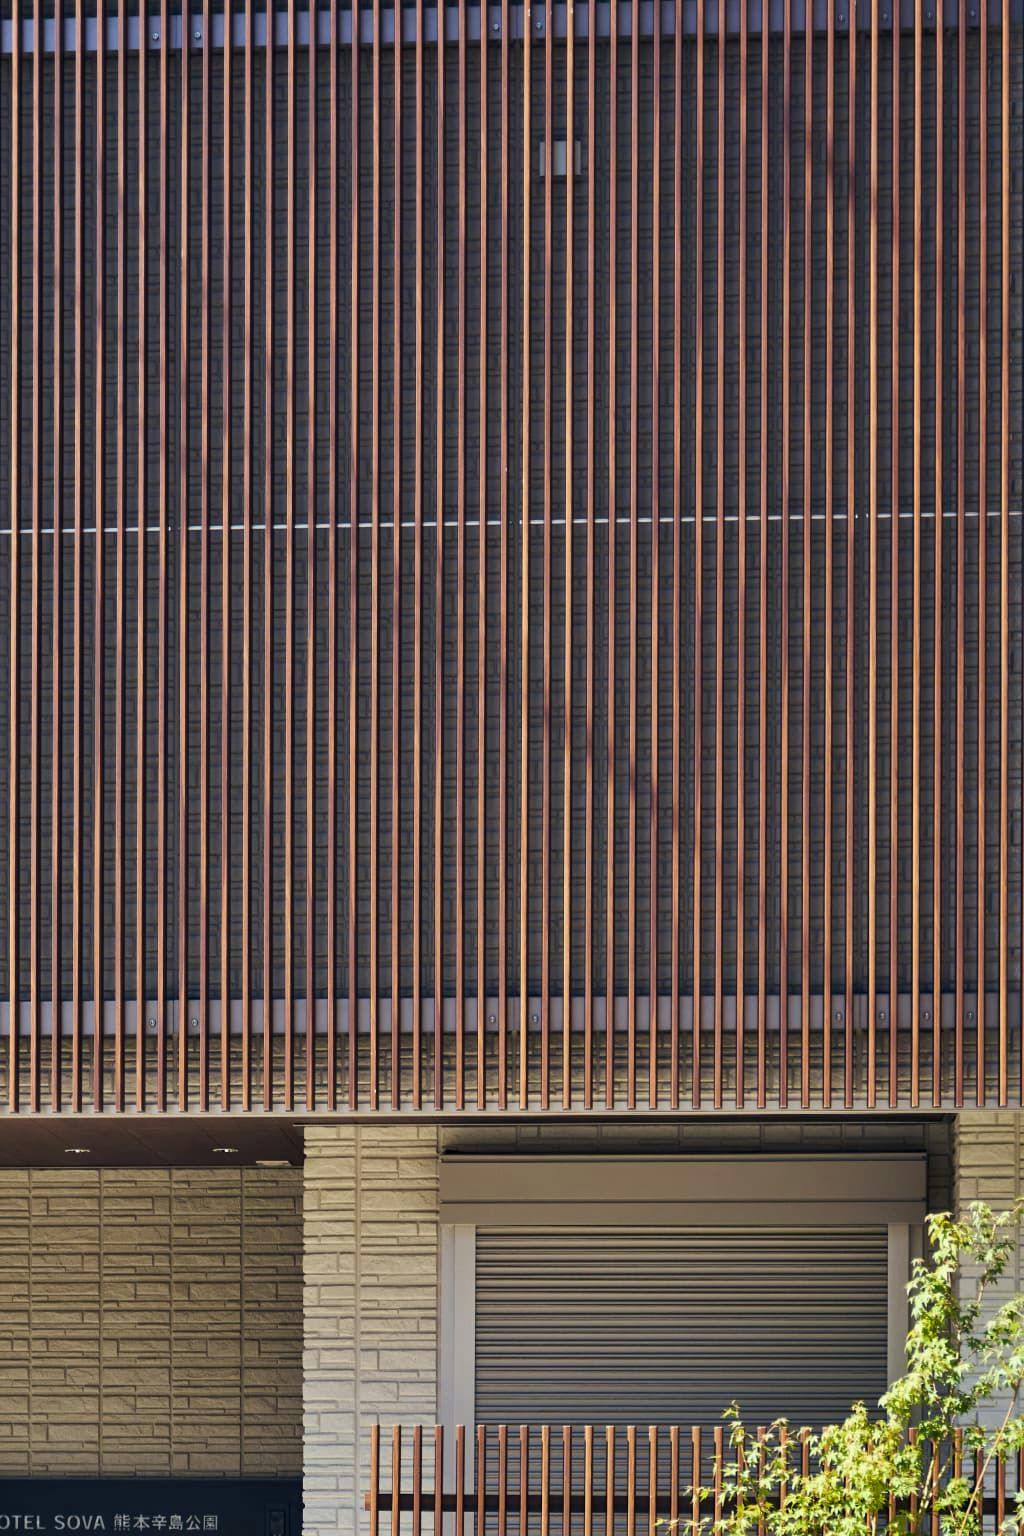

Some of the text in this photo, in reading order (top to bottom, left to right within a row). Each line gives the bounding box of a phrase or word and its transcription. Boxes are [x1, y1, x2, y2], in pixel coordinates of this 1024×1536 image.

[54, 1514, 106, 1530] SOVA
[113, 1513, 218, 1531] 熊本辛島公園
